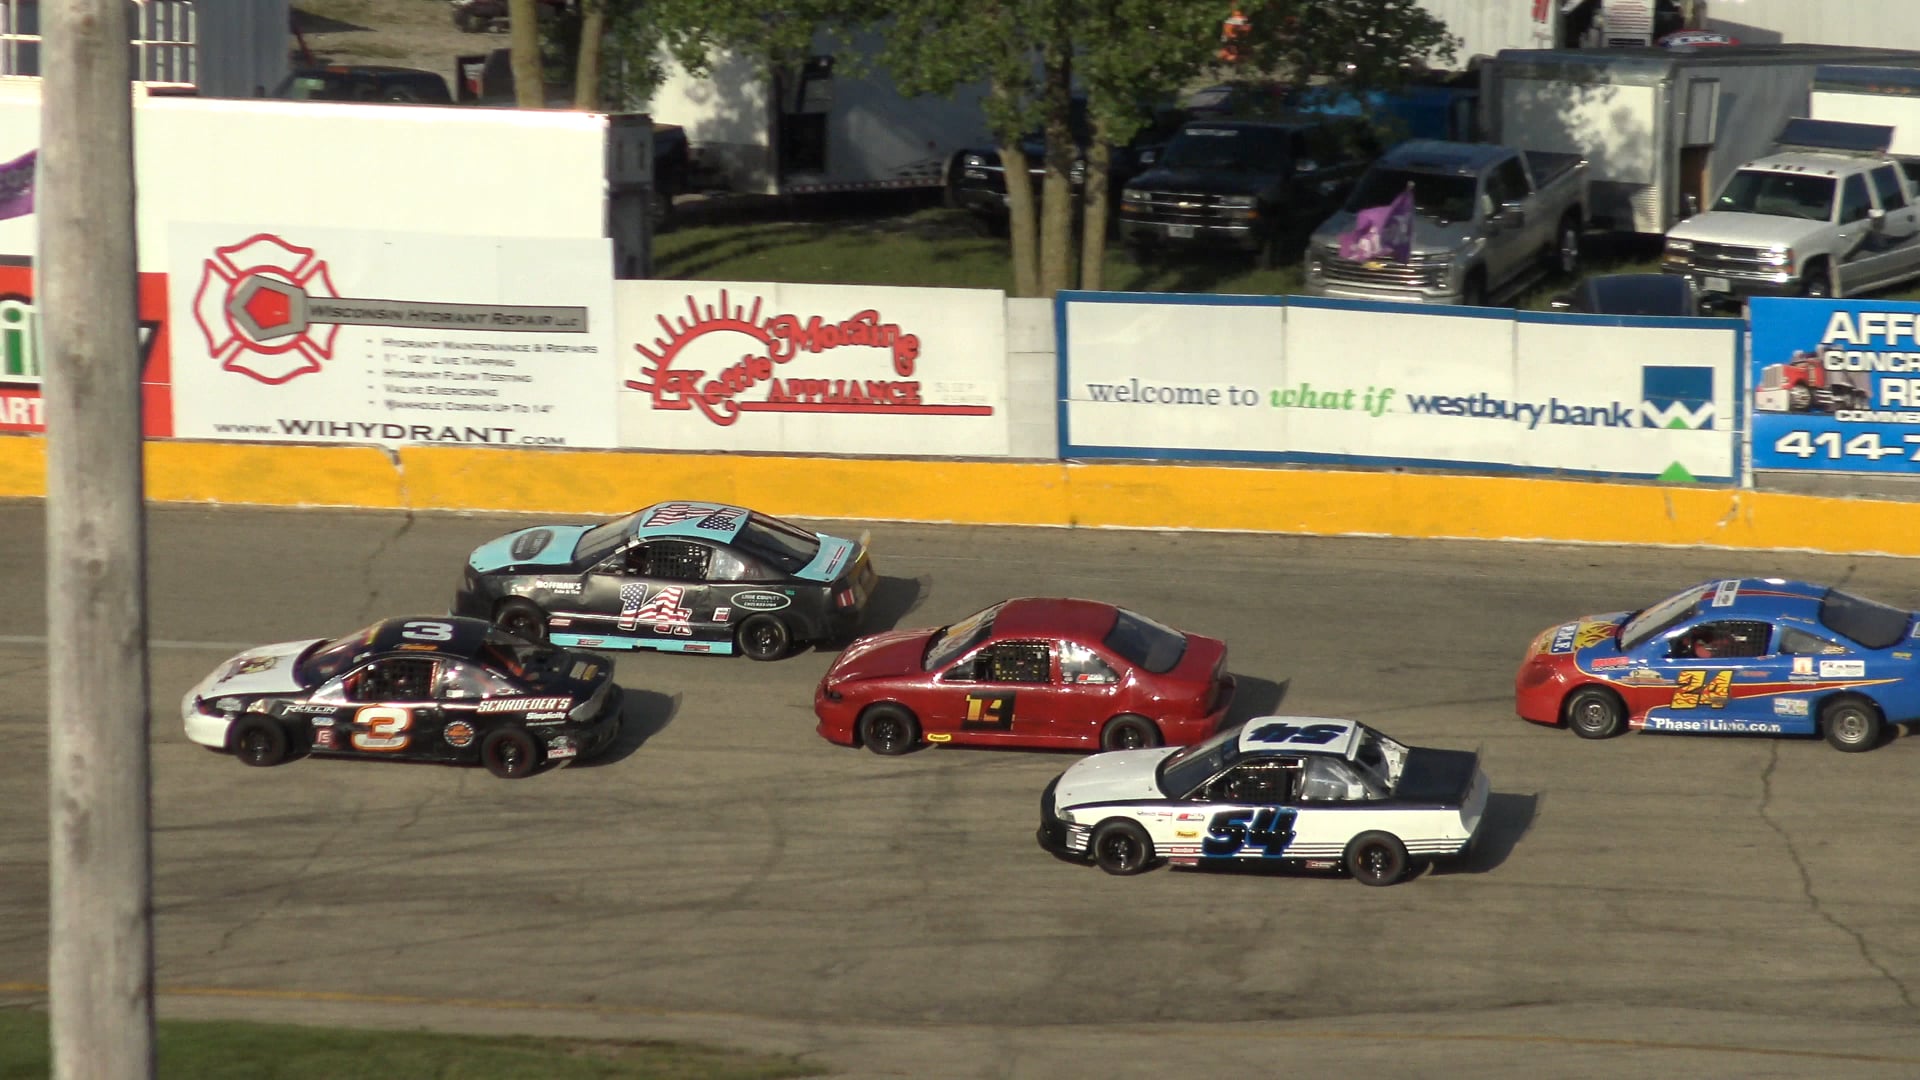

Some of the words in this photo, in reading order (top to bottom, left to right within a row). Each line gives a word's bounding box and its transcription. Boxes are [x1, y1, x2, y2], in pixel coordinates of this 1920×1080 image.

[309, 305, 403, 320] WISCONSIN
[408, 309, 488, 324] HYDRANT
[492, 311, 552, 326] REPAIR
[1821, 311, 1920, 345] AFF
[382, 338, 440, 350] HYDRANT
[545, 343, 597, 354] REPAIRS
[763, 309, 920, 377] Moraine
[383, 369, 441, 380] HYDRANT
[463, 357, 515, 367] TAPPING
[653, 353, 772, 425] Kettle
[766, 378, 921, 405] APPLIANCE
[1086, 378, 1220, 406] welcome
[1228, 385, 1259, 407] to
[1269, 383, 1357, 411] what
[402, 621, 454, 641] 3
[1671, 670, 1733, 709] 24
[477, 698, 572, 713] SCHROEDER'S
[351, 702, 411, 752] 3
[1247, 722, 1349, 745] 54
[1202, 807, 1298, 857] 54
